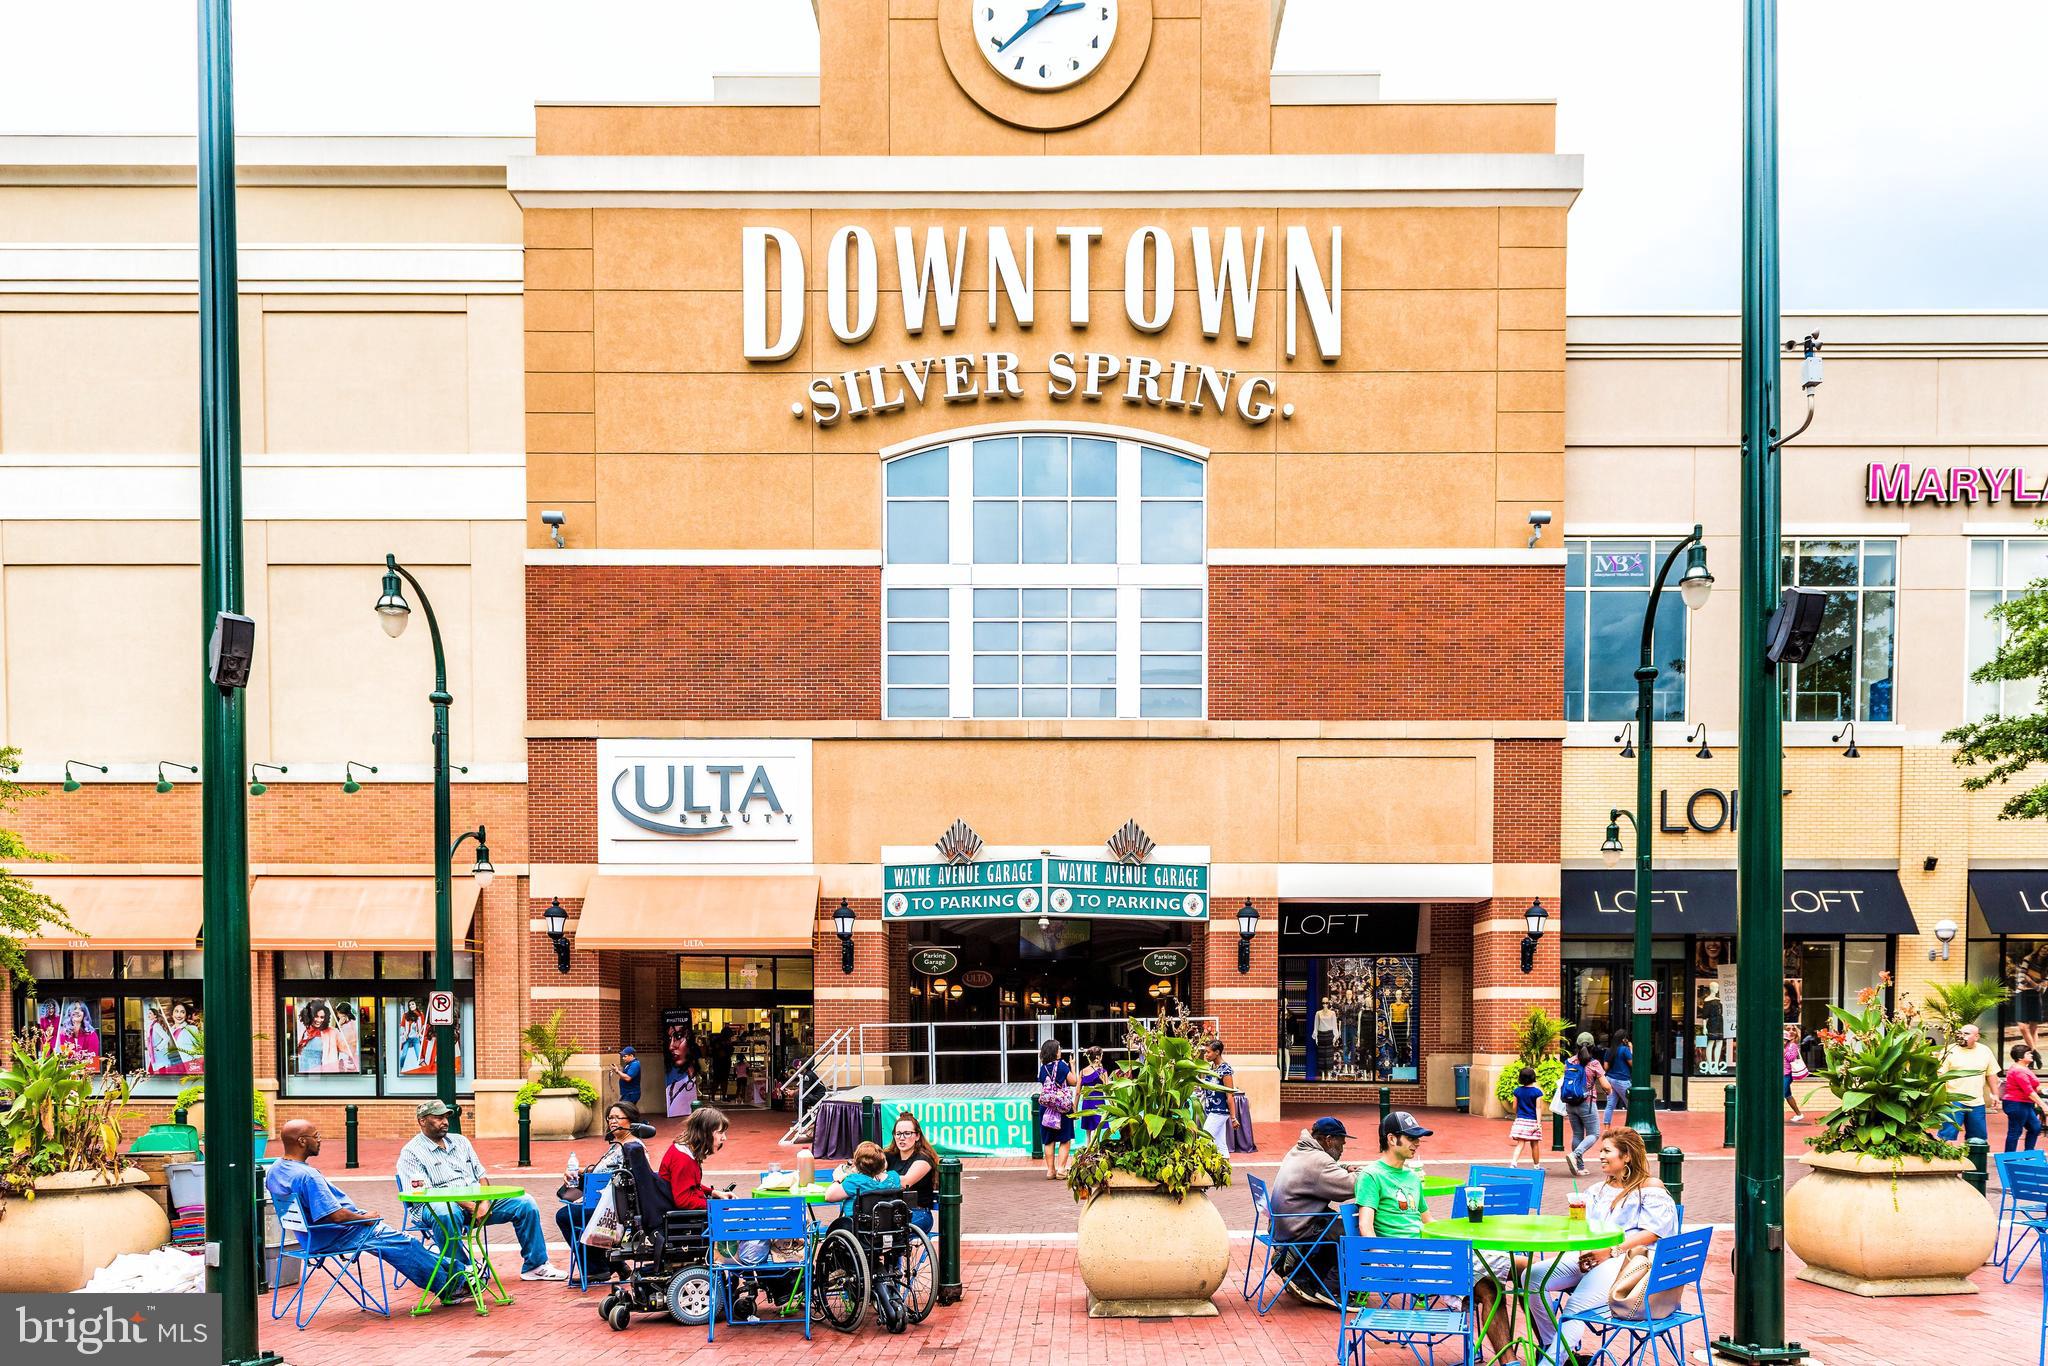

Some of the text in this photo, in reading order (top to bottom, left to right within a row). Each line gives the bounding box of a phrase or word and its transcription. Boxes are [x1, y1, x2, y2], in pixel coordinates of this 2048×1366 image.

[742, 224, 1343, 361] DOWNTOWN
[808, 352, 1276, 425] SILVER SPRING
[1866, 462, 2048, 503] MARYL
[634, 765, 784, 814] ULTA
[679, 813, 793, 825] BEAUTY
[894, 862, 1033, 887] WAYNE AVENUE GARAGE
[1058, 862, 1199, 888] WAYNE AVENUE GARAGE
[912, 894, 1014, 910] TO PARKING
[1077, 894, 1181, 911] TO PARKING
[1283, 913, 1369, 935] LOFT
[68, 940, 89, 948] ULTA
[337, 940, 358, 948] ULTA
[683, 939, 704, 947] ULTA
[923, 952, 947, 960] Parking
[1153, 953, 1177, 961] Parking
[926, 1125, 999, 1146] UNTAIN
